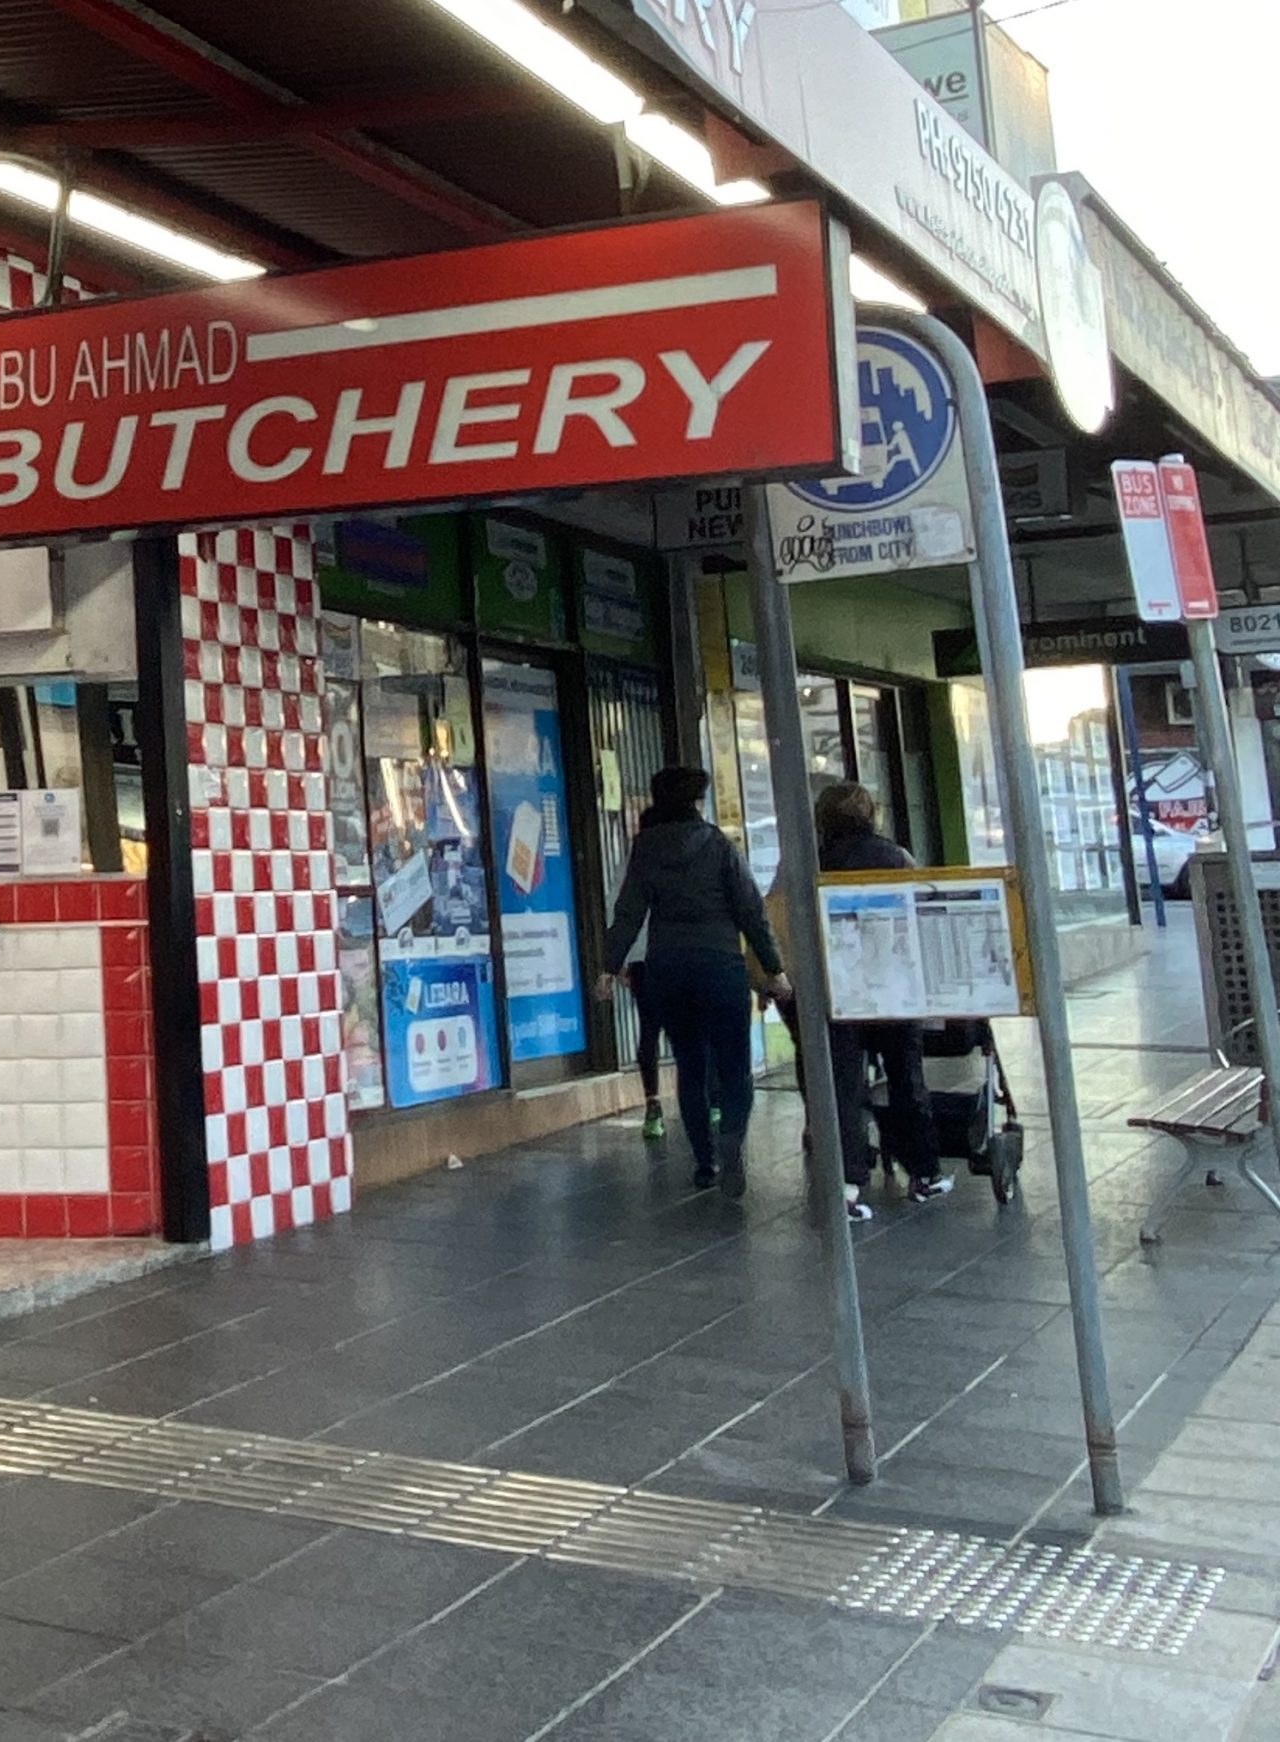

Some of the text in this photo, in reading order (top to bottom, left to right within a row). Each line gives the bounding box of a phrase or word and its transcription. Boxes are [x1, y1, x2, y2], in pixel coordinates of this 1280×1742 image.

[68, 319, 239, 401] AHMAD
[1121, 473, 1153, 494] BUS
[1124, 495, 1158, 516] ZONE
[878, 539, 913, 560] CITY
[1026, 625, 1148, 653] rominent
